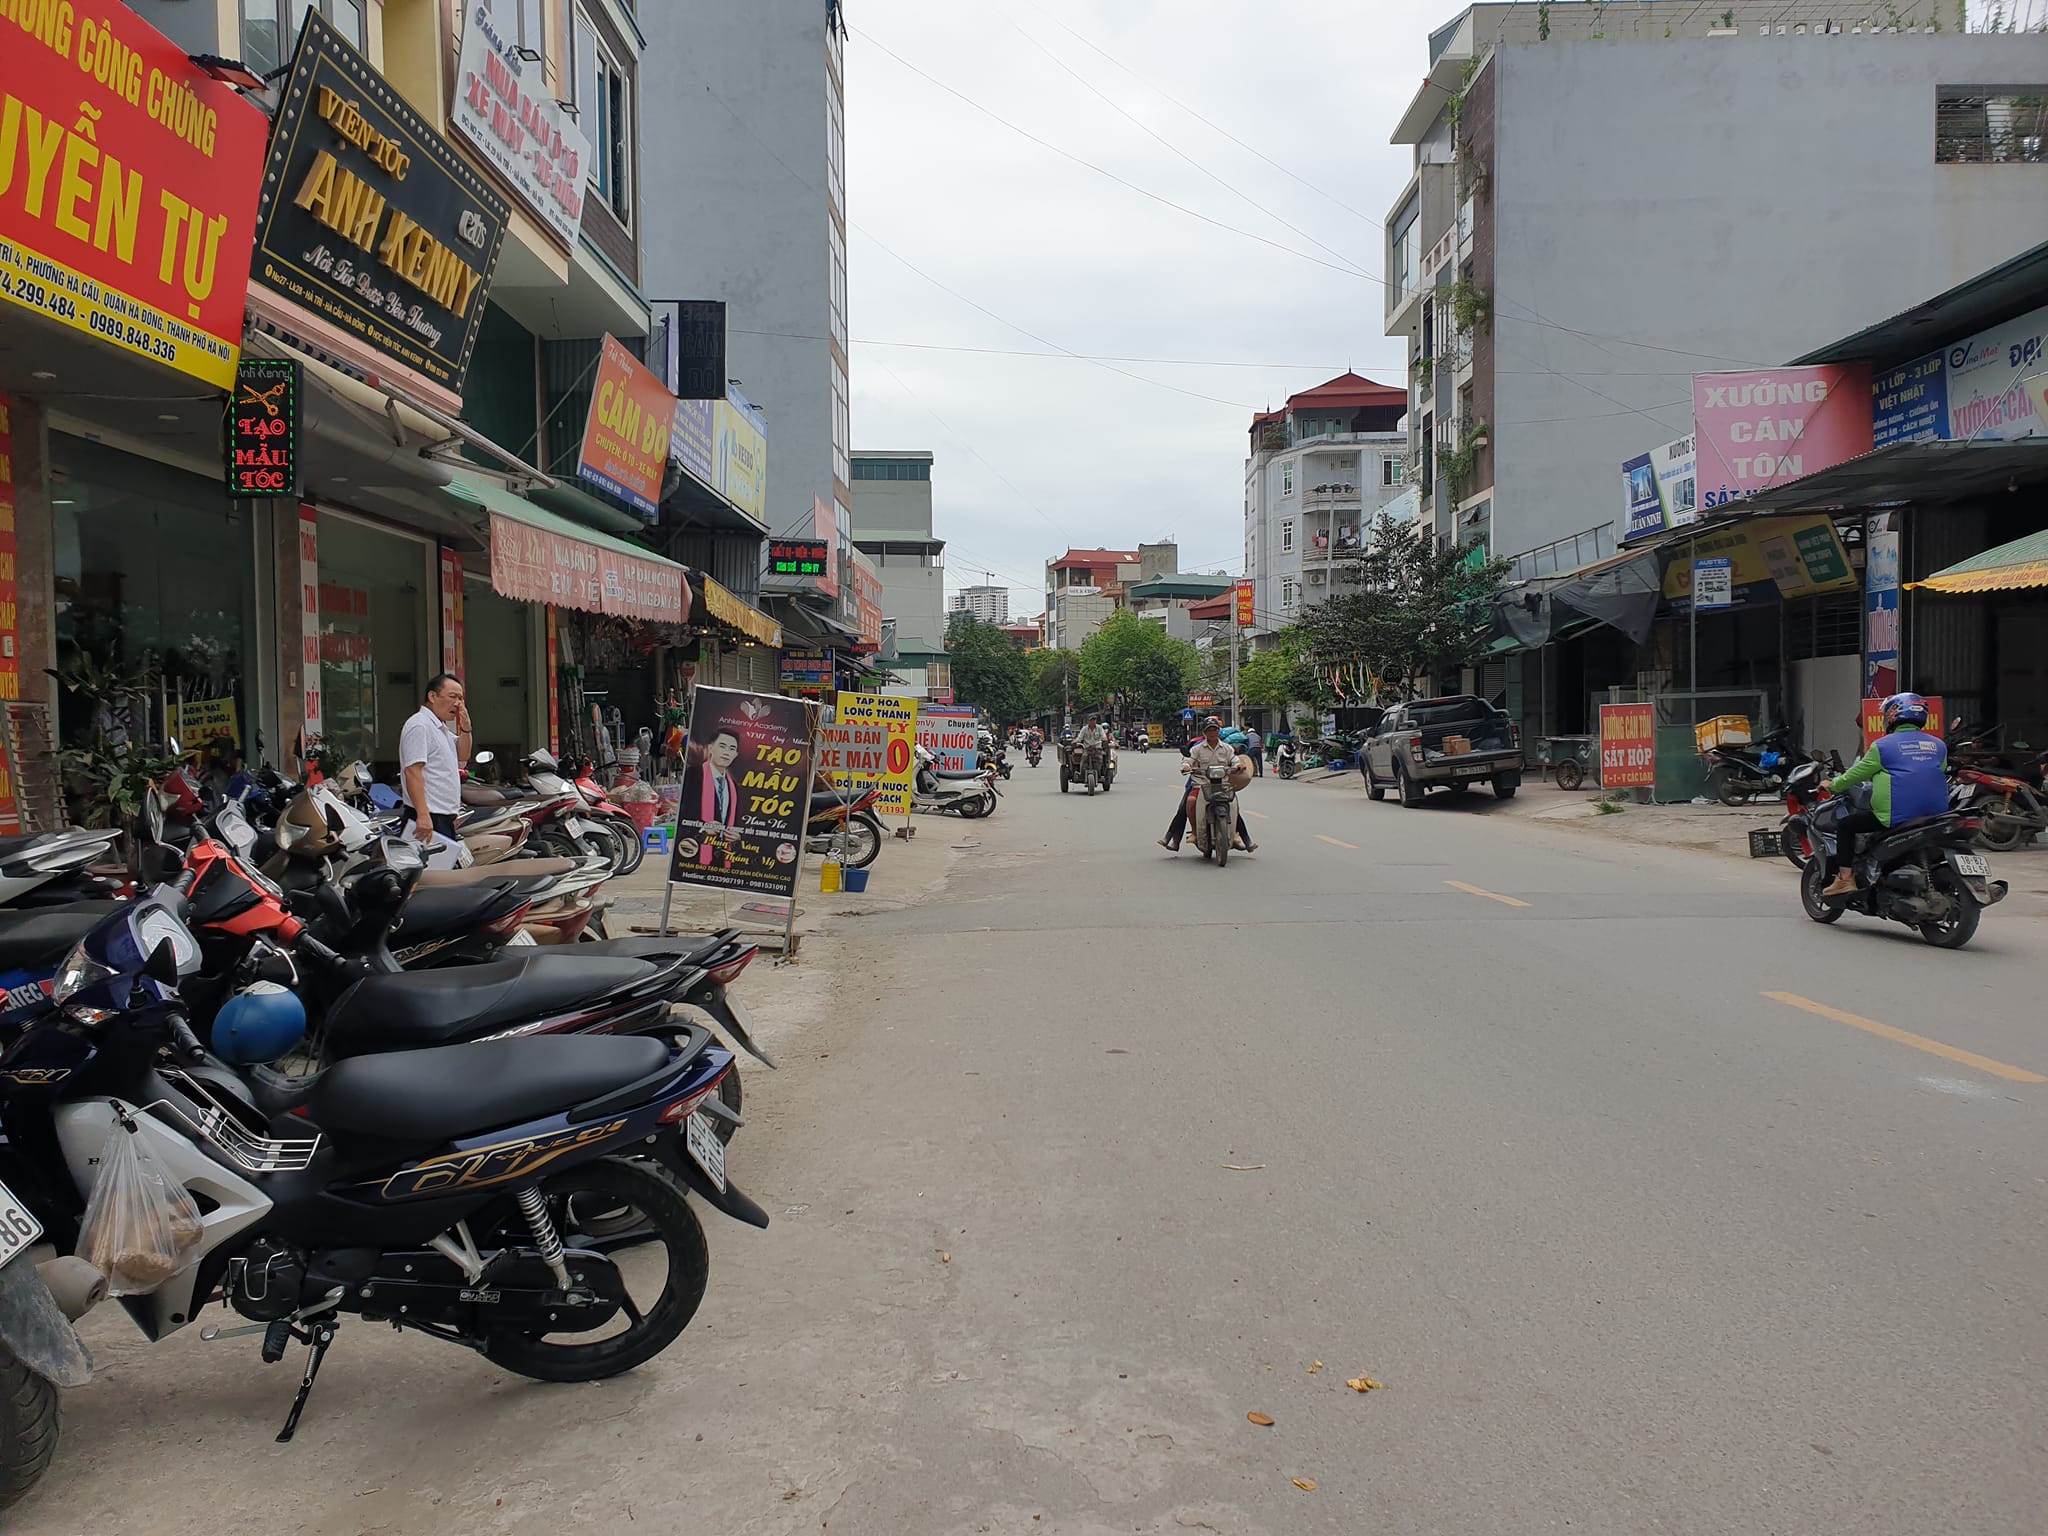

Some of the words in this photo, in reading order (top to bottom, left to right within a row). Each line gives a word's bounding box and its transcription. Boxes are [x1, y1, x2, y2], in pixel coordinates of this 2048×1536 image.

[78, 18, 144, 108] CÔNG
[146, 67, 218, 159] CHỨNG
[486, 49, 519, 110] MUA
[521, 94, 551, 148] BÁN
[319, 85, 376, 152] VIỆN
[468, 71, 491, 118] XE
[493, 98, 525, 155] MÁY
[535, 150, 554, 188] XE
[293, 150, 387, 254] ANH
[378, 204, 483, 320] KENNY
[158, 188, 228, 321] TỰ
[25, 255, 65, 286] PHƯỜNG
[66, 271, 80, 294] HÀ
[102, 291, 127, 315] QUẬN
[128, 299, 140, 320] HÀ
[166, 319, 190, 345] THÀNH
[192, 331, 207, 351] PHỐ
[207, 337, 218, 356] HÀ
[217, 341, 231, 362] NỘI
[89, 309, 176, 363] 0989.848.336
[2009, 335, 2042, 368] ĐẠI
[257, 366, 290, 382] Kenny
[1703, 377, 1829, 409] XƯỞNG
[1900, 383, 1925, 403] NHẬT
[238, 417, 286, 440] TẠO
[597, 375, 642, 447] CẦM
[642, 412, 671, 464] ĐỒ
[1729, 417, 1806, 443] CÁN
[235, 443, 289, 466] MẪU
[1732, 452, 1804, 479] TÔN
[240, 468, 285, 489] TÓC
[304, 584, 317, 614] TIN
[303, 630, 320, 666] NHÀ
[306, 681, 320, 720] ĐẤT
[844, 707, 873, 717] LONG
[876, 709, 911, 720] THANH
[753, 720, 789, 733] Academy
[823, 729, 851, 744] MUA
[854, 727, 881, 745] BÁN
[947, 719, 976, 729] Chuyên
[941, 731, 975, 751] NƯỚC
[756, 743, 802, 767] TẠO
[820, 749, 841, 768] XE
[845, 747, 884, 771] MÁY
[943, 753, 965, 772] KHÍ
[1603, 741, 1625, 768] SẮT
[1627, 743, 1653, 770] HỘP
[741, 767, 801, 794] MẪU
[750, 794, 796, 817] TÓC
[703, 835, 730, 850] Phun
